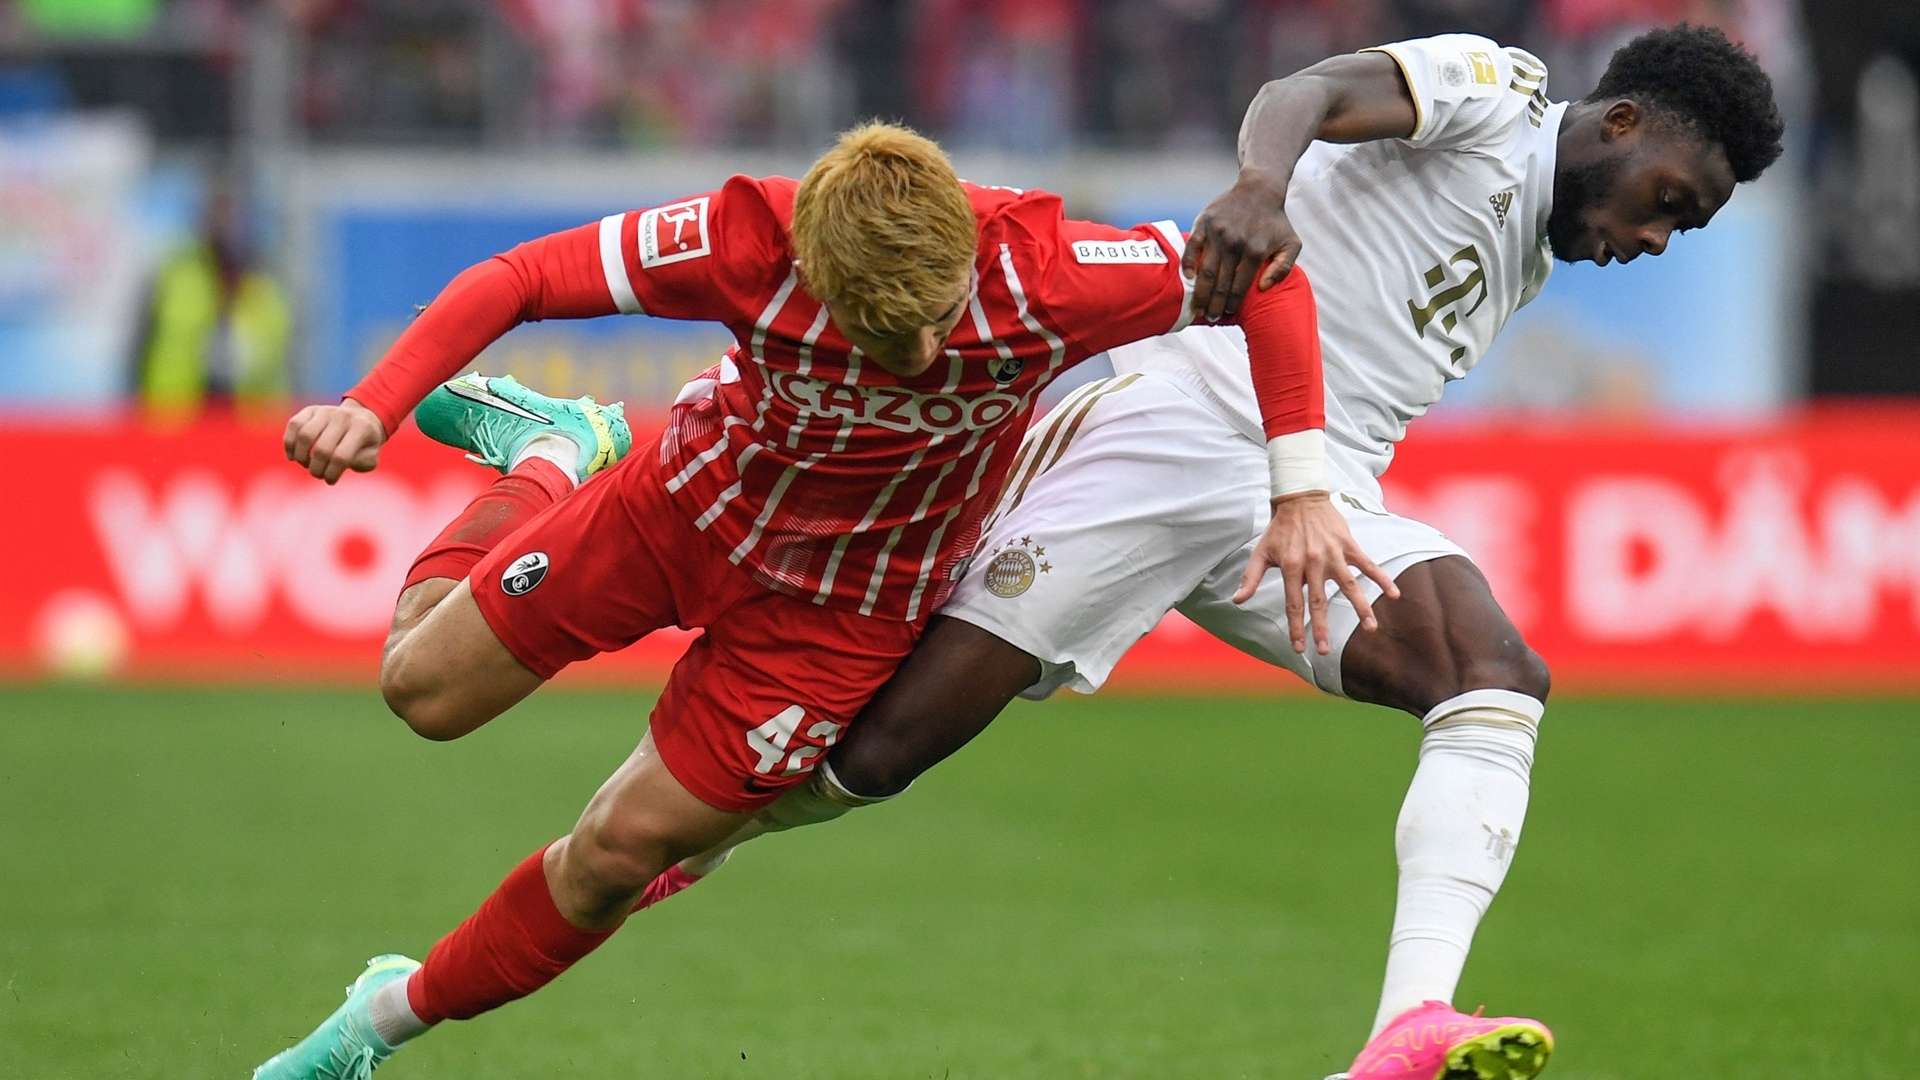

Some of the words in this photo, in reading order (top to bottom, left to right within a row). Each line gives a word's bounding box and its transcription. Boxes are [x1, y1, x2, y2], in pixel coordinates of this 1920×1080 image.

[1078, 245, 1162, 258] BABISTA
[774, 371, 1016, 431] CAZOO
[746, 704, 841, 777] 42
